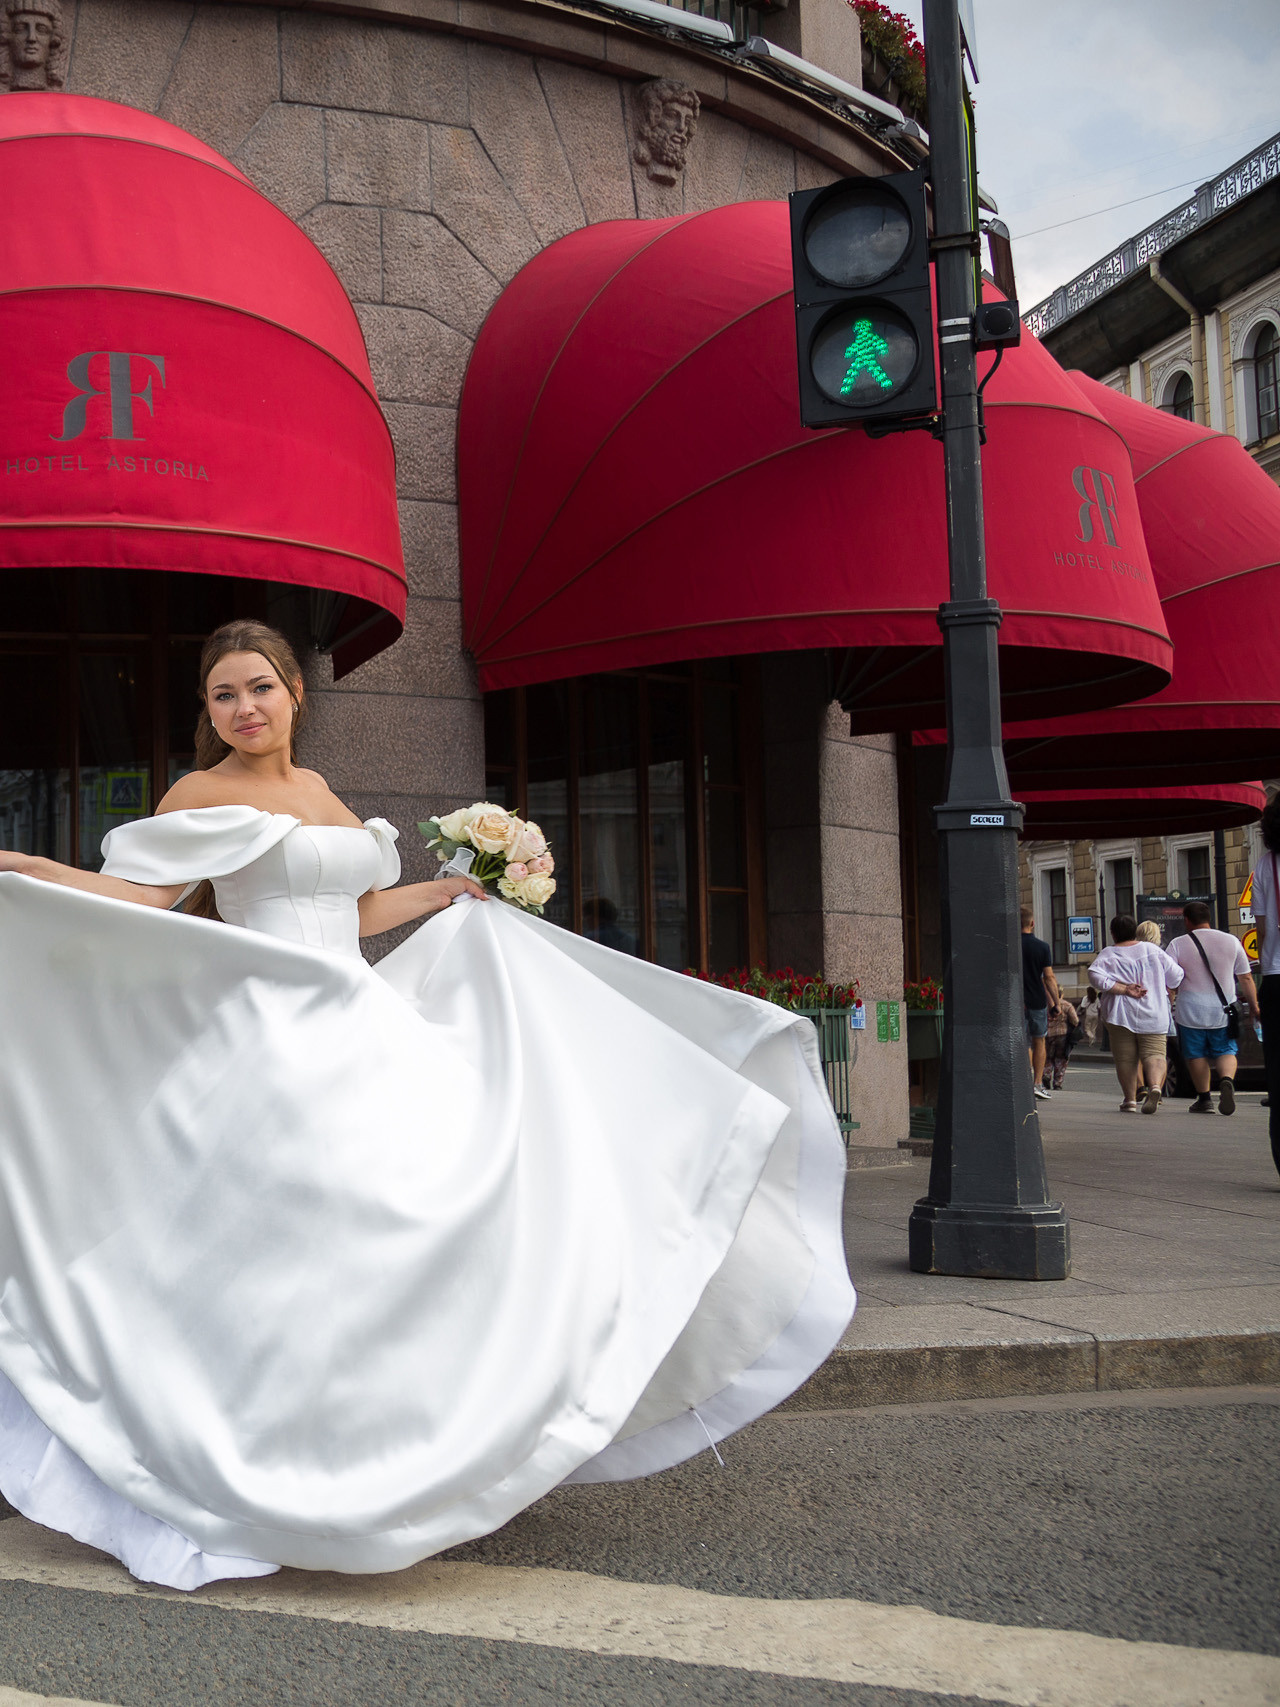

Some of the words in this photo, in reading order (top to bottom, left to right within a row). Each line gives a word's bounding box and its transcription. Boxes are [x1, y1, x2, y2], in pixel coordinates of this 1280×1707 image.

[6, 455, 89, 475] HOTEL
[107, 455, 209, 481] ASTORIA
[1053, 551, 1104, 570] HOTEL
[1111, 560, 1148, 583] ASTORIA
